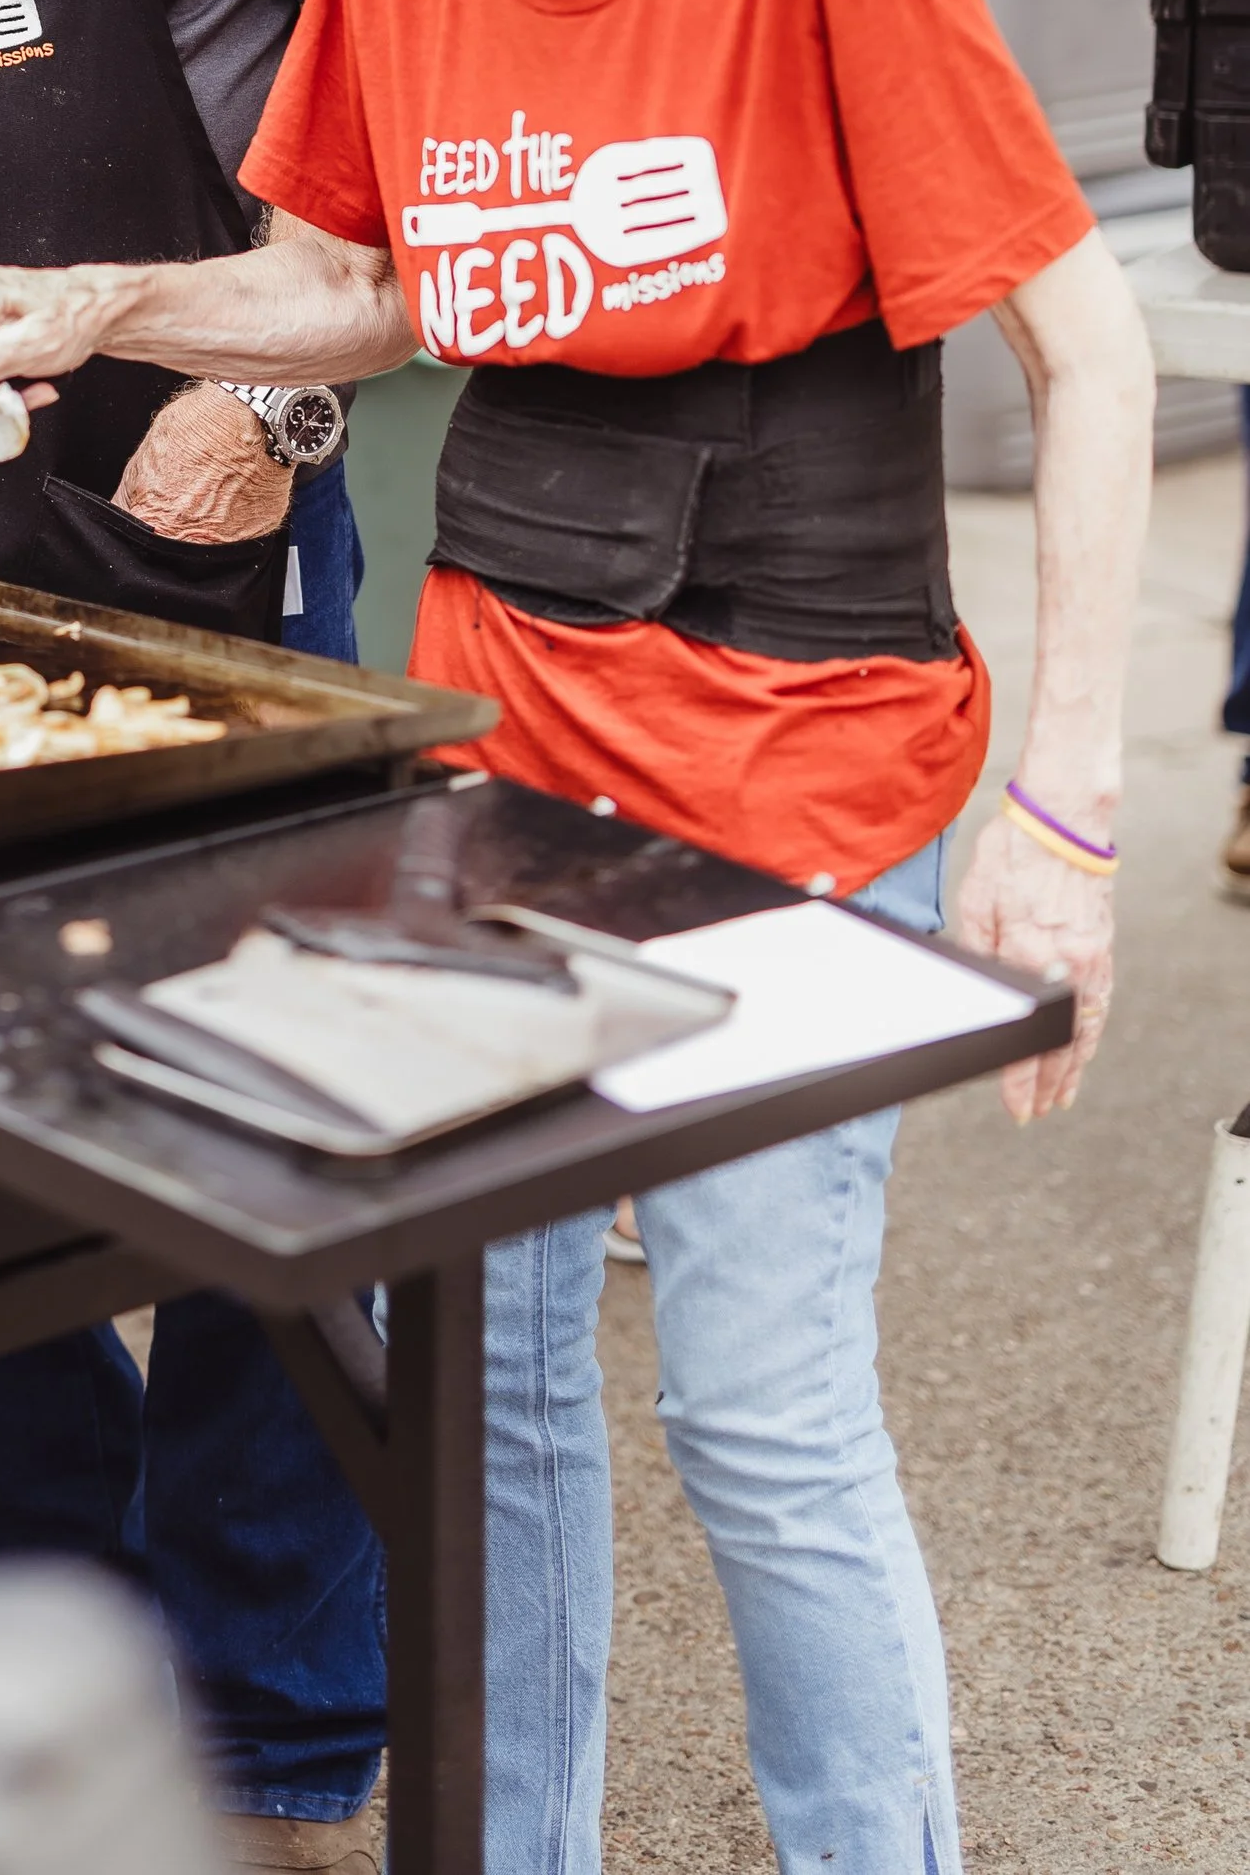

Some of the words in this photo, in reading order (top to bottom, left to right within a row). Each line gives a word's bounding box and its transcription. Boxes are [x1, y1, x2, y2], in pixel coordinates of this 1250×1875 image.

[419, 136, 500, 197] FEED
[419, 232, 594, 357] NEED
[602, 252, 726, 312] missions
